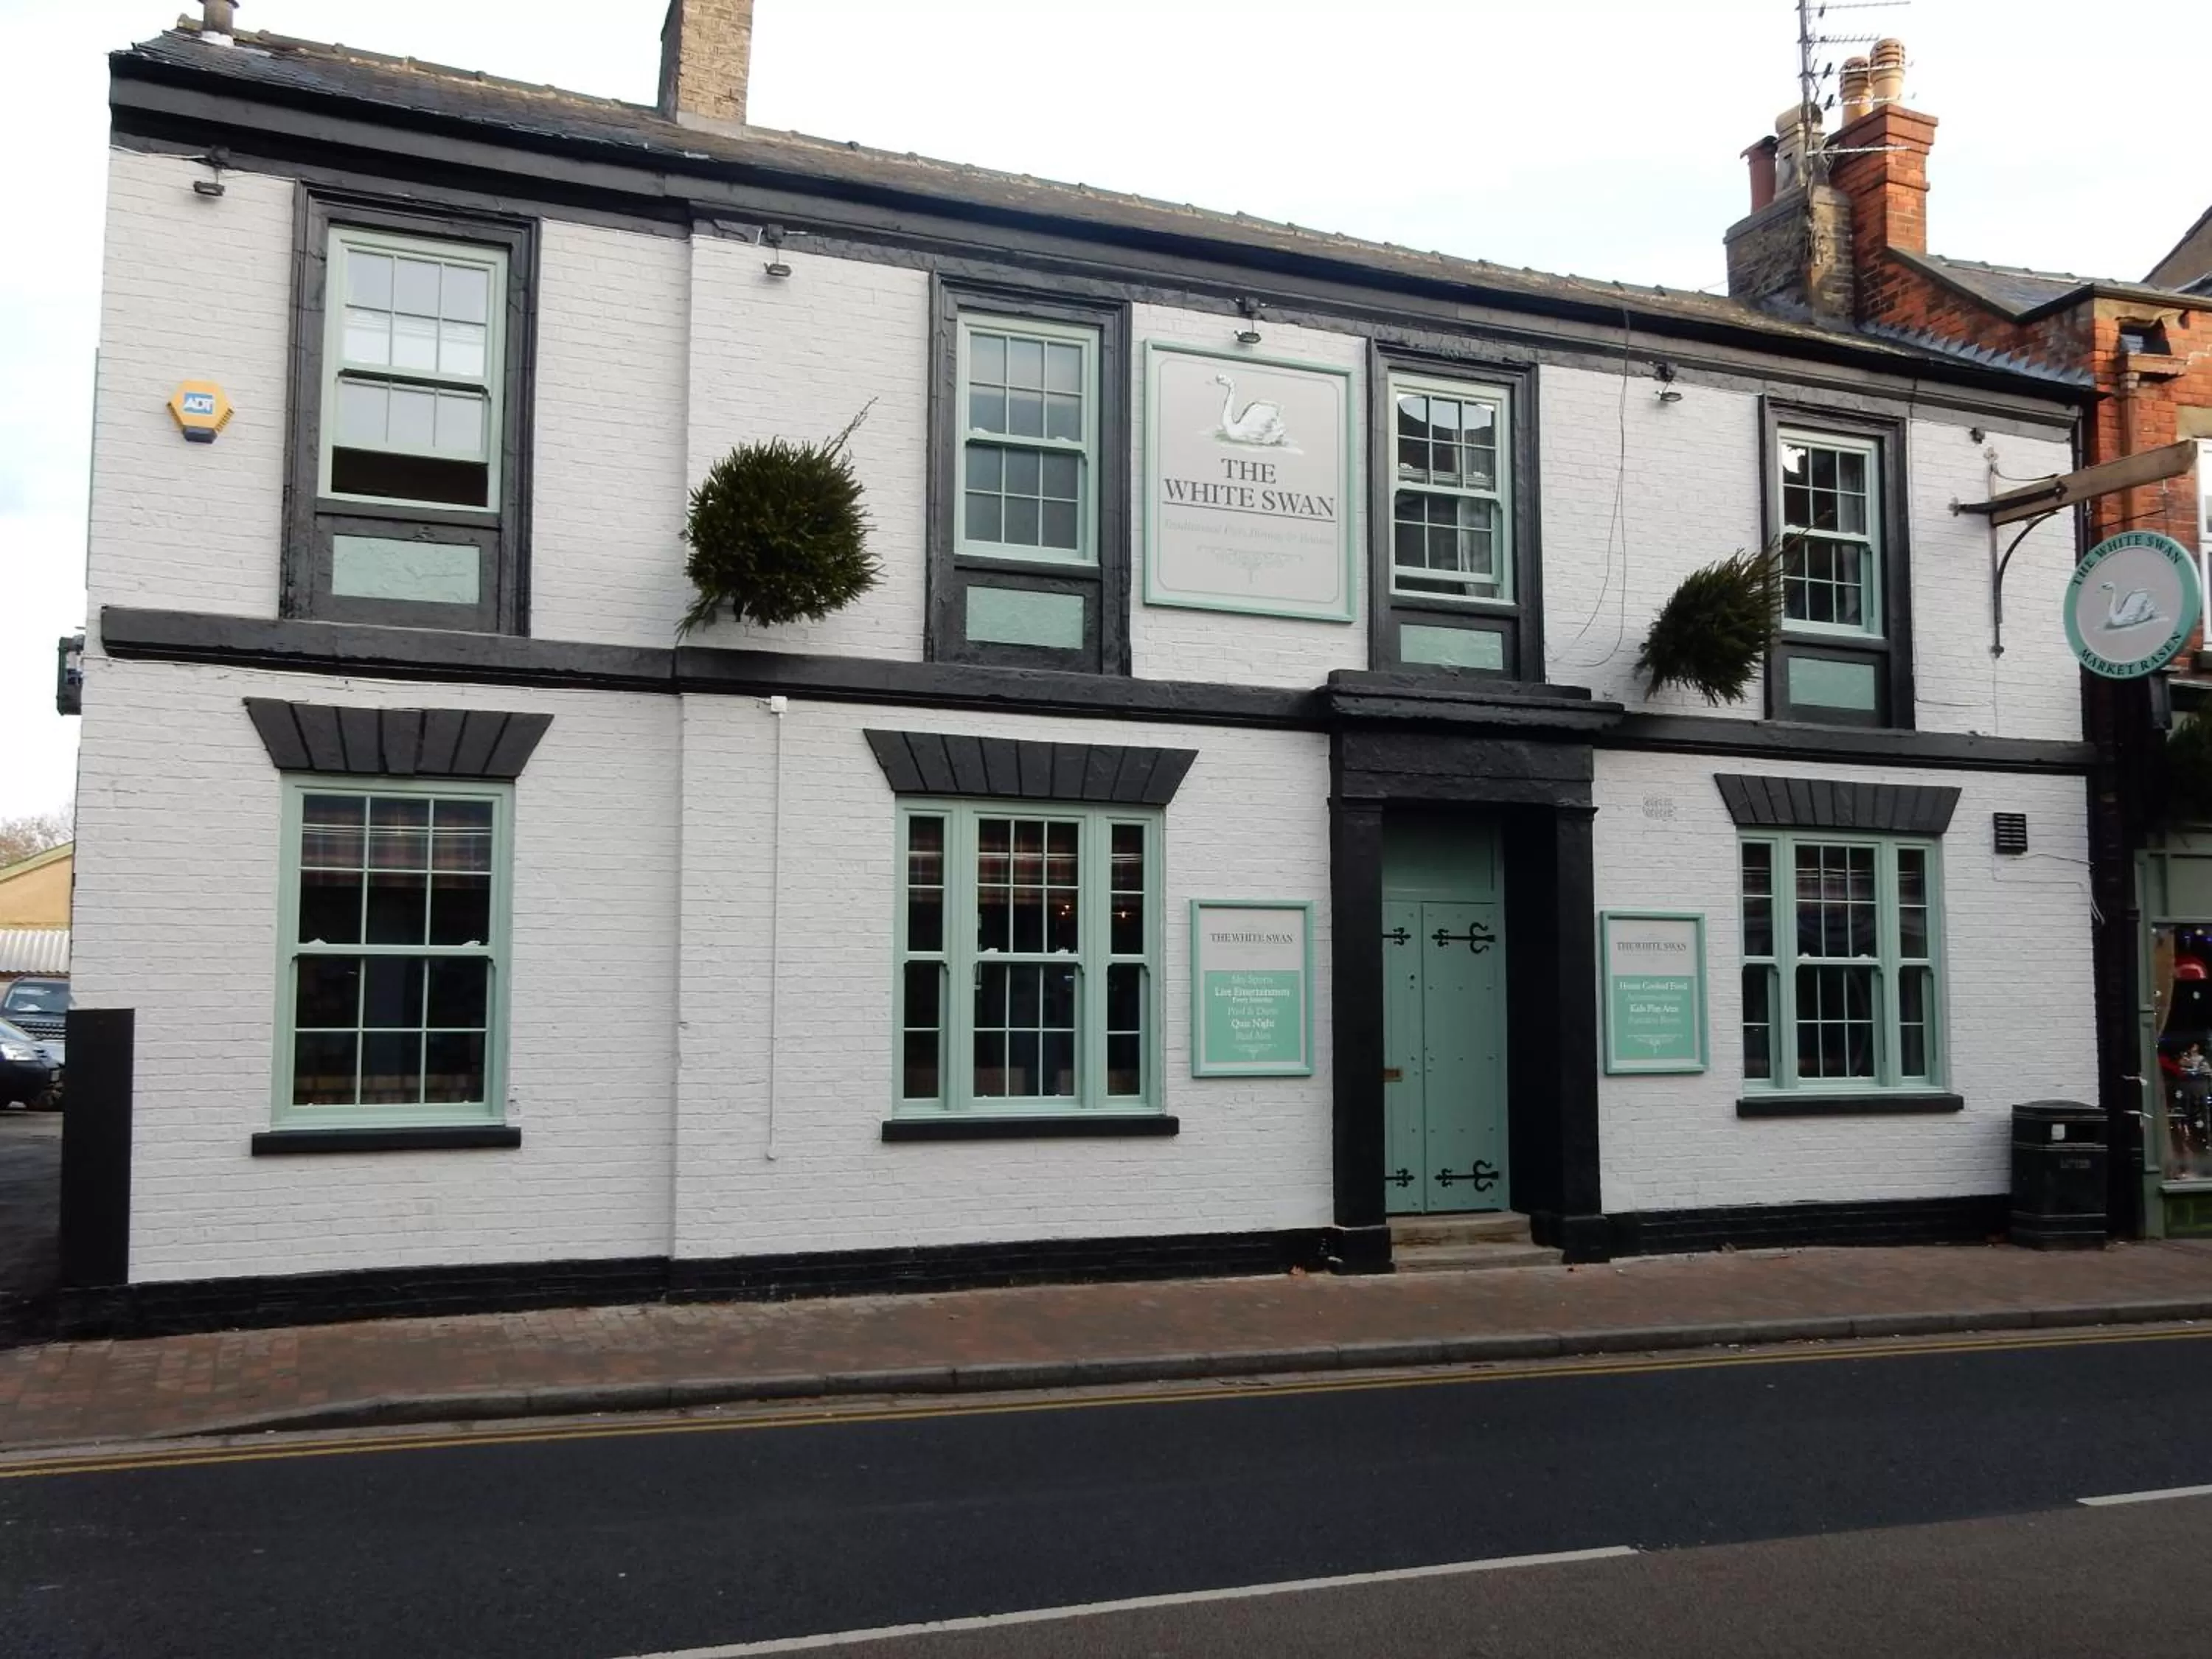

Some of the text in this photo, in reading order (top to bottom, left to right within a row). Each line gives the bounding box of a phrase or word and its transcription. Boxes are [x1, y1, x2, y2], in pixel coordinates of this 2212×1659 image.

[183, 397, 214, 412] ADT
[1221, 458, 1276, 484] THE
[1164, 479, 1335, 517] WHITE SWAN
[2072, 535, 2183, 586] THE WHITE SWAN
[2081, 630, 2182, 675] MARKET RASEN
[1209, 932, 1293, 945] THE WHITE SWAN
